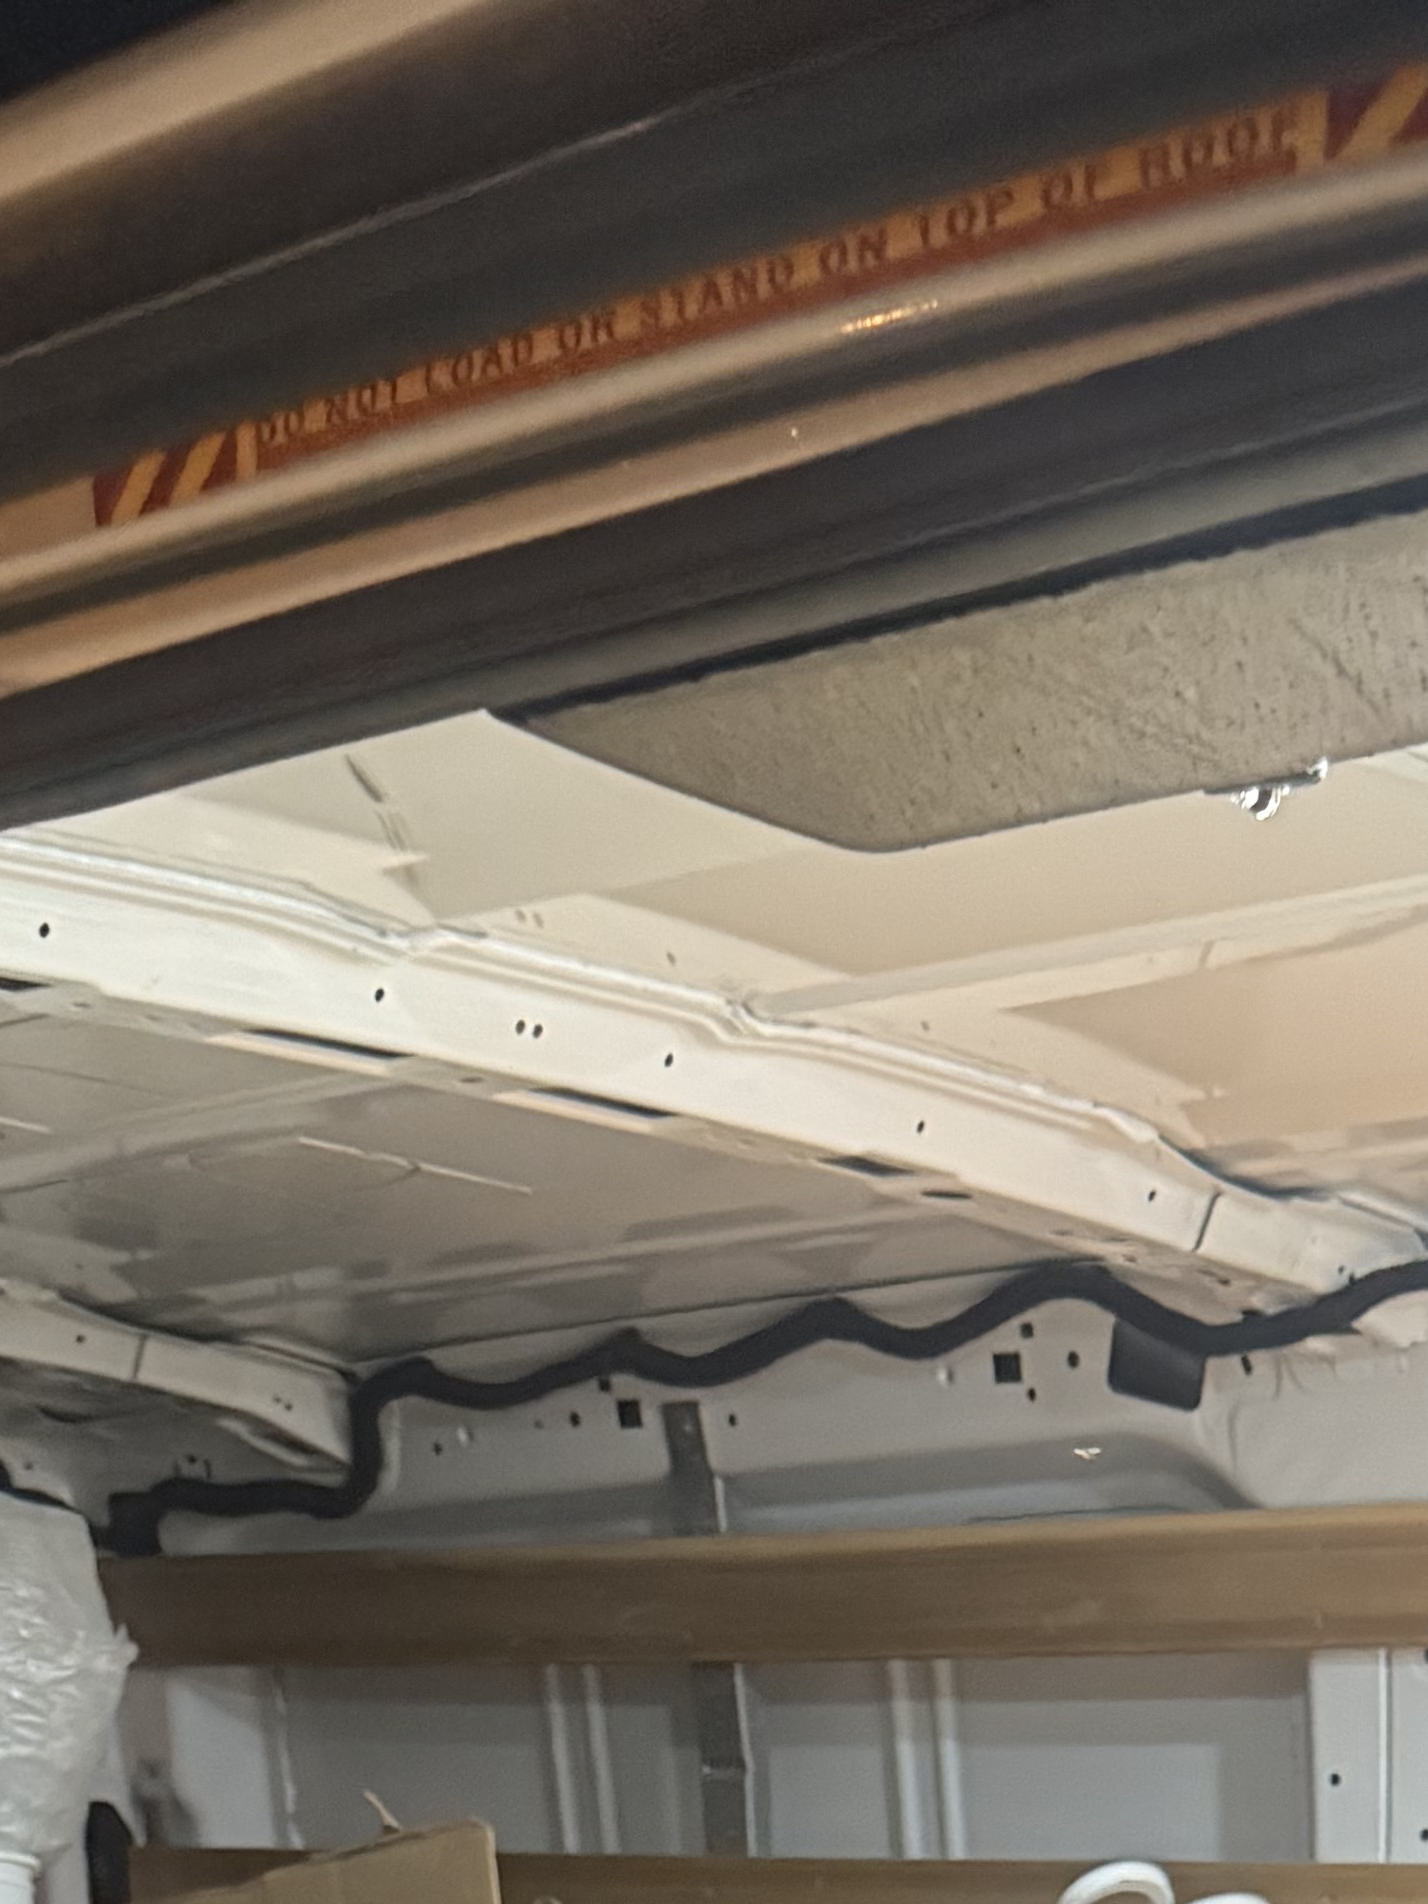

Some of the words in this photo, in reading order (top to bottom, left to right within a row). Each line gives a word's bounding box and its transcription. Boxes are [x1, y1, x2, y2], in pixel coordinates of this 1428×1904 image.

[258, 408, 305, 444] DO
[326, 378, 401, 426] NOT
[426, 332, 534, 395] LOAD
[560, 313, 616, 361] OR
[639, 255, 795, 327] STAND
[819, 226, 887, 277] ON
[920, 188, 1015, 246] TOP
[1139, 105, 1297, 186] ROOF
